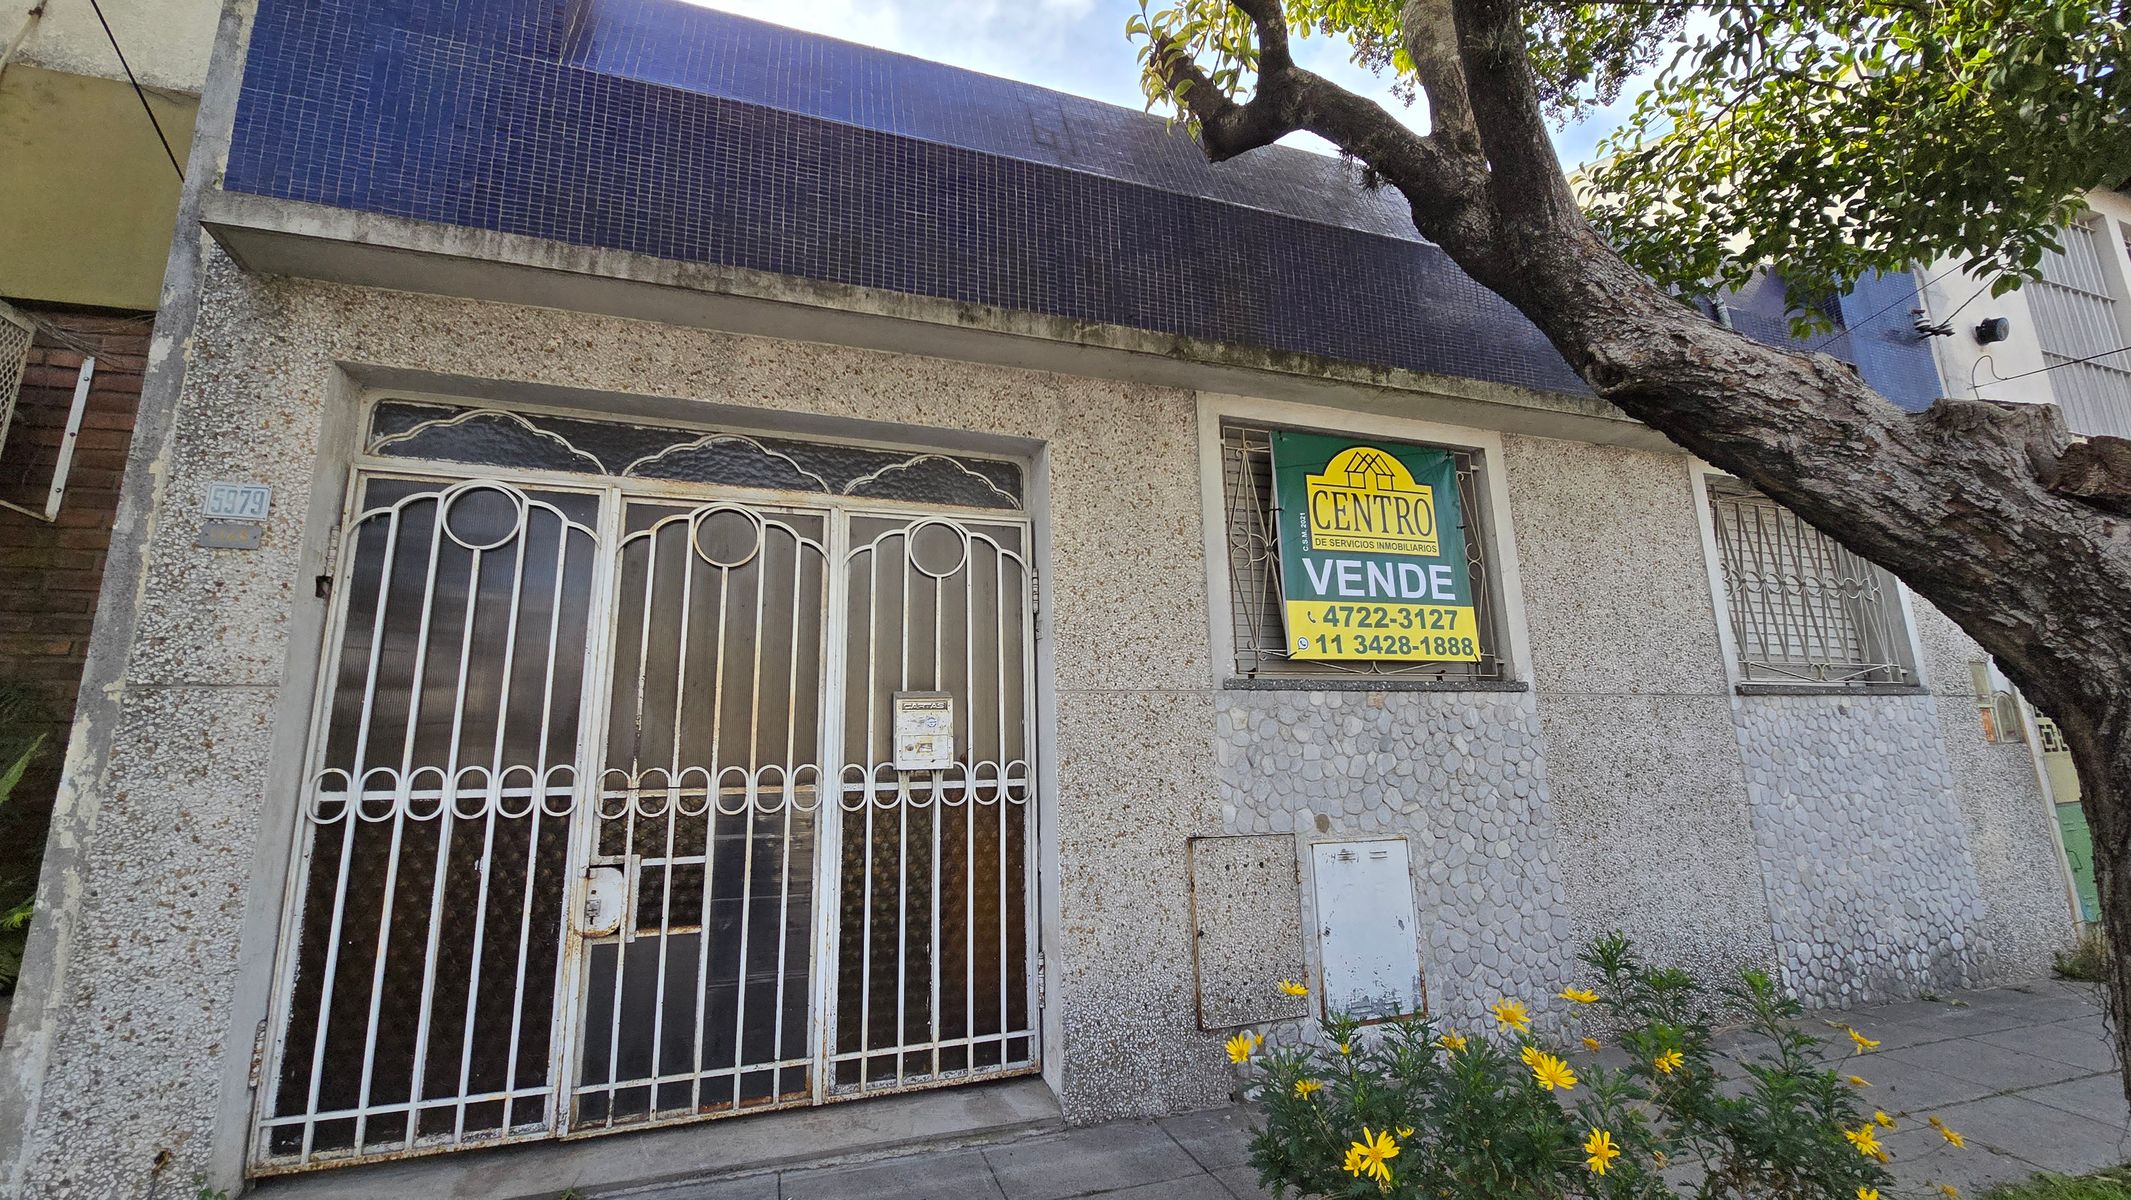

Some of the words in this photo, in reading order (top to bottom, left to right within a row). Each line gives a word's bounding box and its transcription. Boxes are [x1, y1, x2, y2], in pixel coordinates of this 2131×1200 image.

[210, 487, 265, 515] 5979
[1312, 489, 1434, 537] CENTRO
[1299, 512, 1307, 529] 2021
[1315, 538, 1327, 547] DE
[1329, 539, 1375, 549] SERVICIOS
[1376, 541, 1437, 553] INMOBILIARIOS
[1302, 558, 1456, 600] VENDE
[1323, 605, 1458, 631] 4722-3127
[1315, 634, 1343, 654] 11
[1353, 635, 1475, 656] 3428-1888
